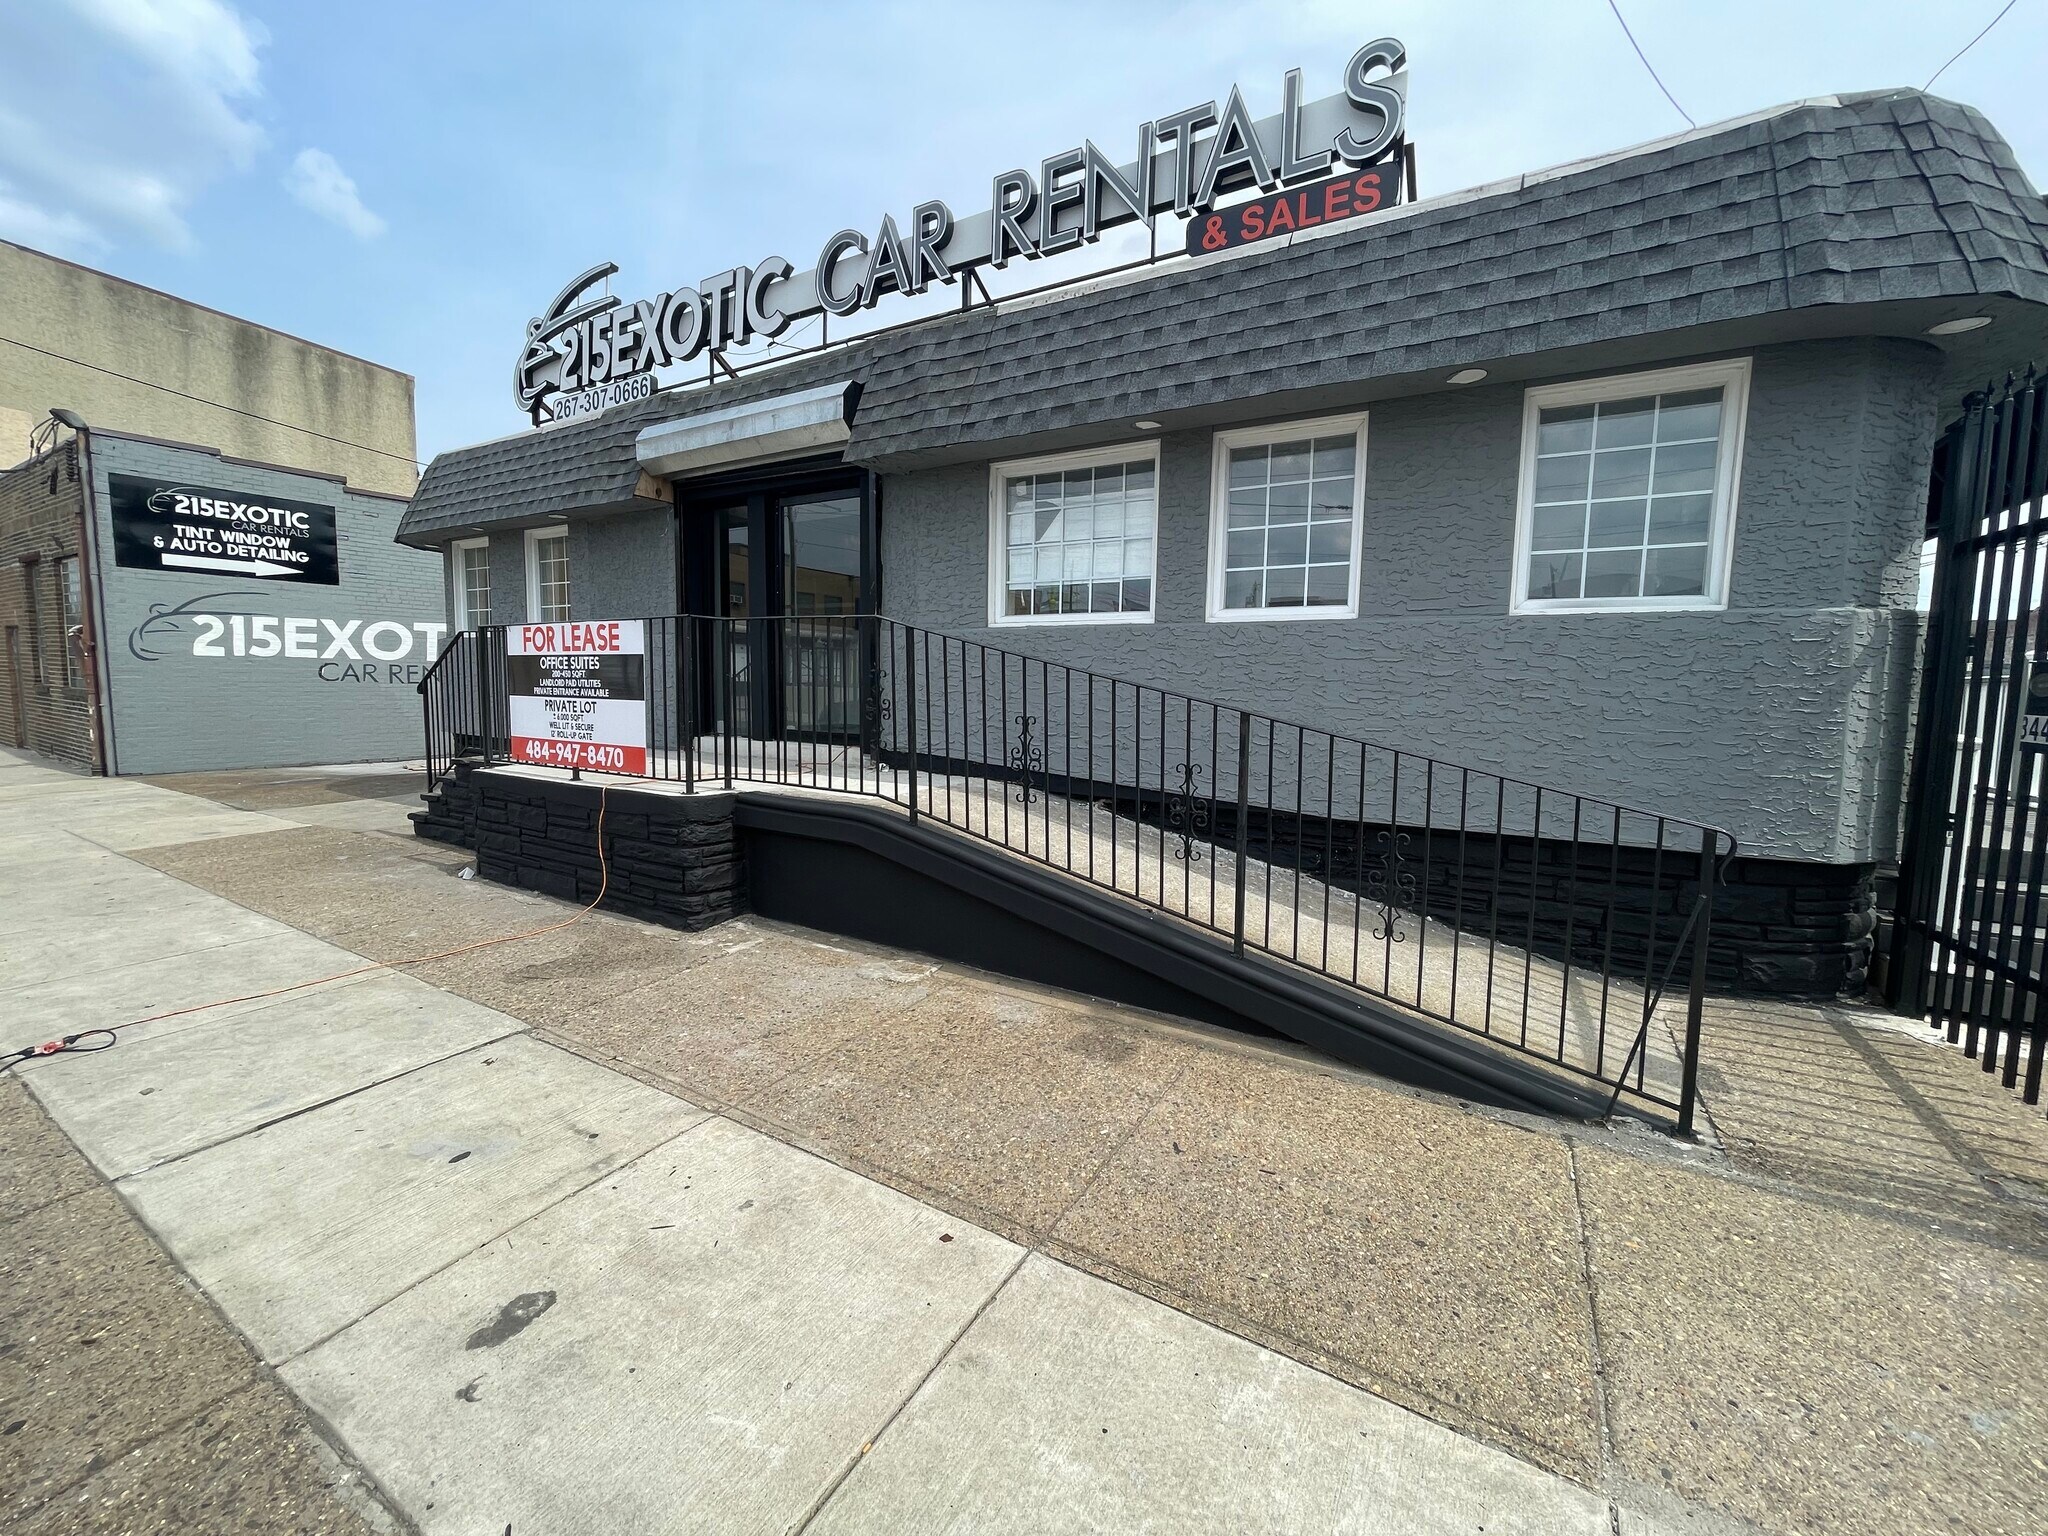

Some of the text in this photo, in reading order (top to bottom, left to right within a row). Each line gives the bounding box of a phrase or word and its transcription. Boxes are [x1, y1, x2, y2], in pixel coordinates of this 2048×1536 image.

[560, 37, 1406, 393] 215EXOTIC CAR RENTALS
[1201, 173, 1382, 251] & SALES
[556, 376, 649, 420] 267-307-0666
[174, 495, 310, 529] 215EXOTIC
[172, 524, 291, 549] TINT WINDOW
[231, 520, 310, 538] CAR RENTALS
[153, 535, 310, 563] & AUTO DETAILING
[522, 623, 620, 652] FOR LEASE
[318, 662, 379, 683] CAR
[540, 656, 600, 669] OFFICE SUITES
[533, 687, 609, 697] PRIVATE ENTRANCE AVAILABLE
[539, 679, 601, 687] LANDLORD PAID UTILITIES
[544, 699, 597, 714] PRIVATE LOT
[549, 721, 561, 729] WELL
[575, 723, 594, 731] SECURE
[557, 731, 577, 739] ROLL-UP
[578, 732, 593, 740] GATE
[525, 739, 624, 768] 484-947-8470
